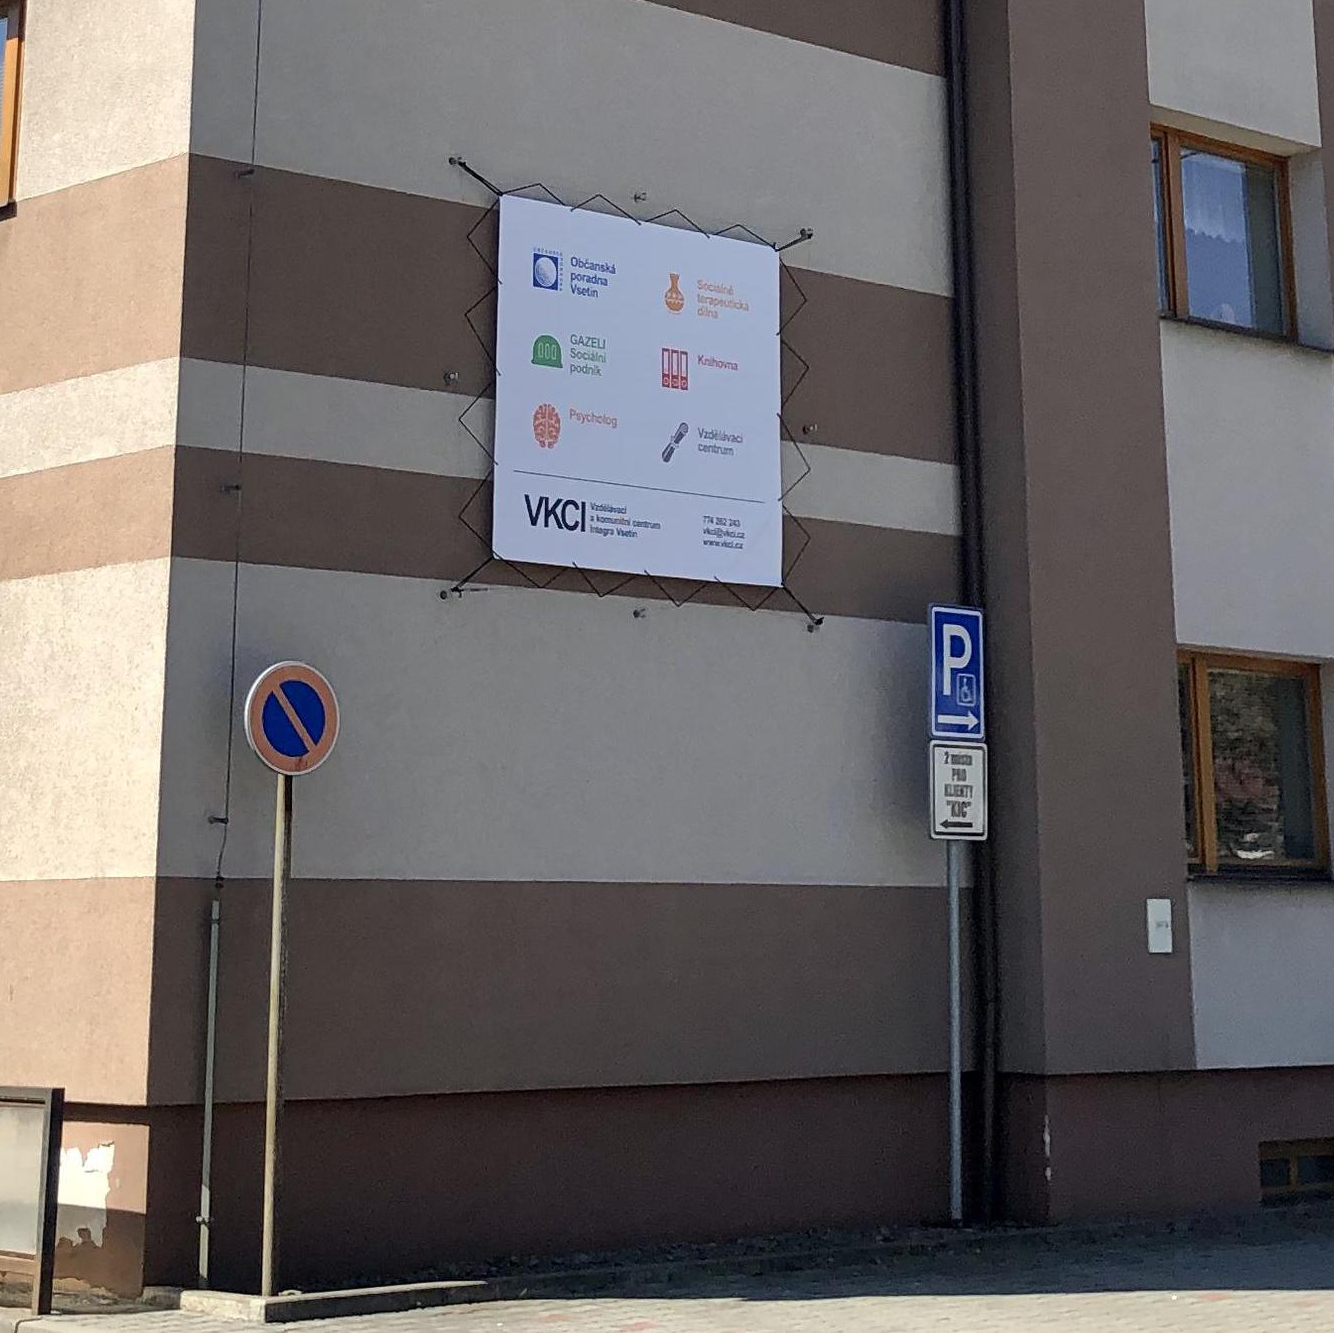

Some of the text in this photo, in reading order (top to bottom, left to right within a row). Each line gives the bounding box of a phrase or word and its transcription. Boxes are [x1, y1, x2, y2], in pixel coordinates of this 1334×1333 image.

[571, 272, 608, 286] poradna
[570, 363, 602, 376] podnik
[698, 354, 738, 370] Knihovna
[570, 408, 617, 428] Psycholog
[698, 443, 734, 456] centrum
[524, 494, 586, 532] VKCI
[942, 623, 972, 696] P
